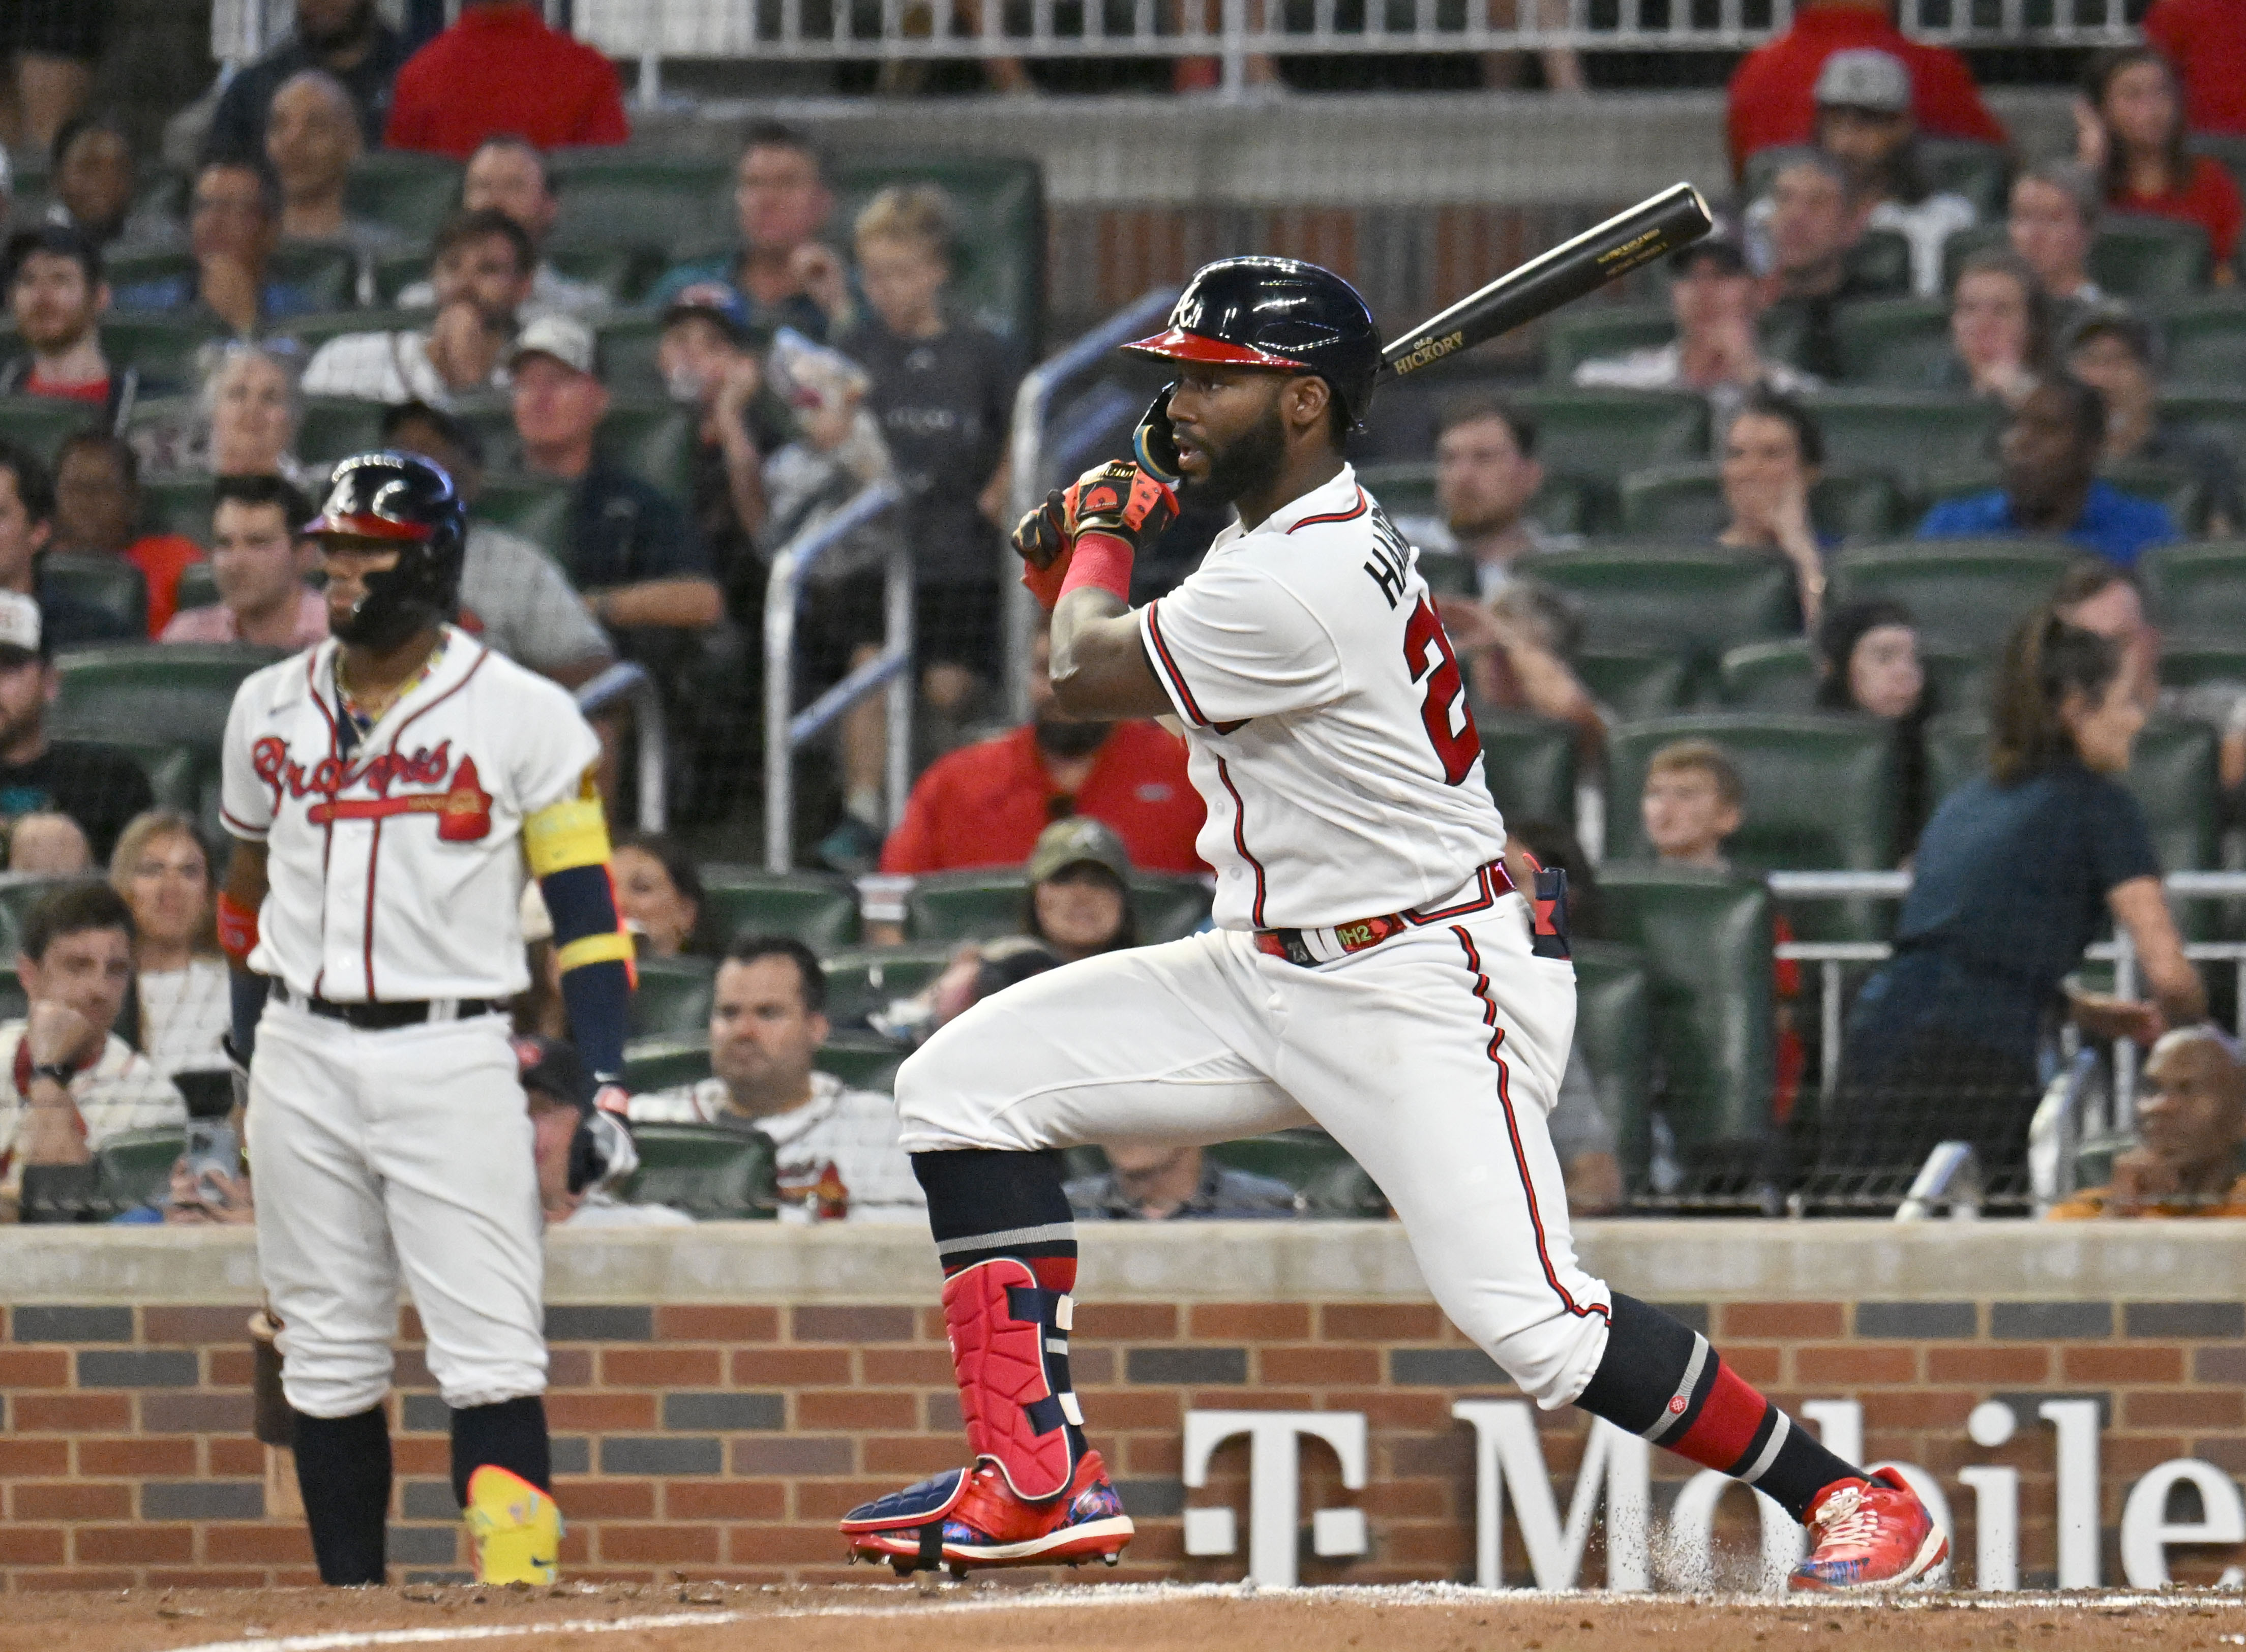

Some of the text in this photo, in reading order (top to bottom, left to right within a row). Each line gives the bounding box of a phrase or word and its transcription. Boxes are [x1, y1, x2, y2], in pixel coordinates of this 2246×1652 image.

[1393, 331, 1463, 376] HICKORY
[1403, 594, 1482, 787] 2
[1451, 1399, 2246, 1590] Mobile
